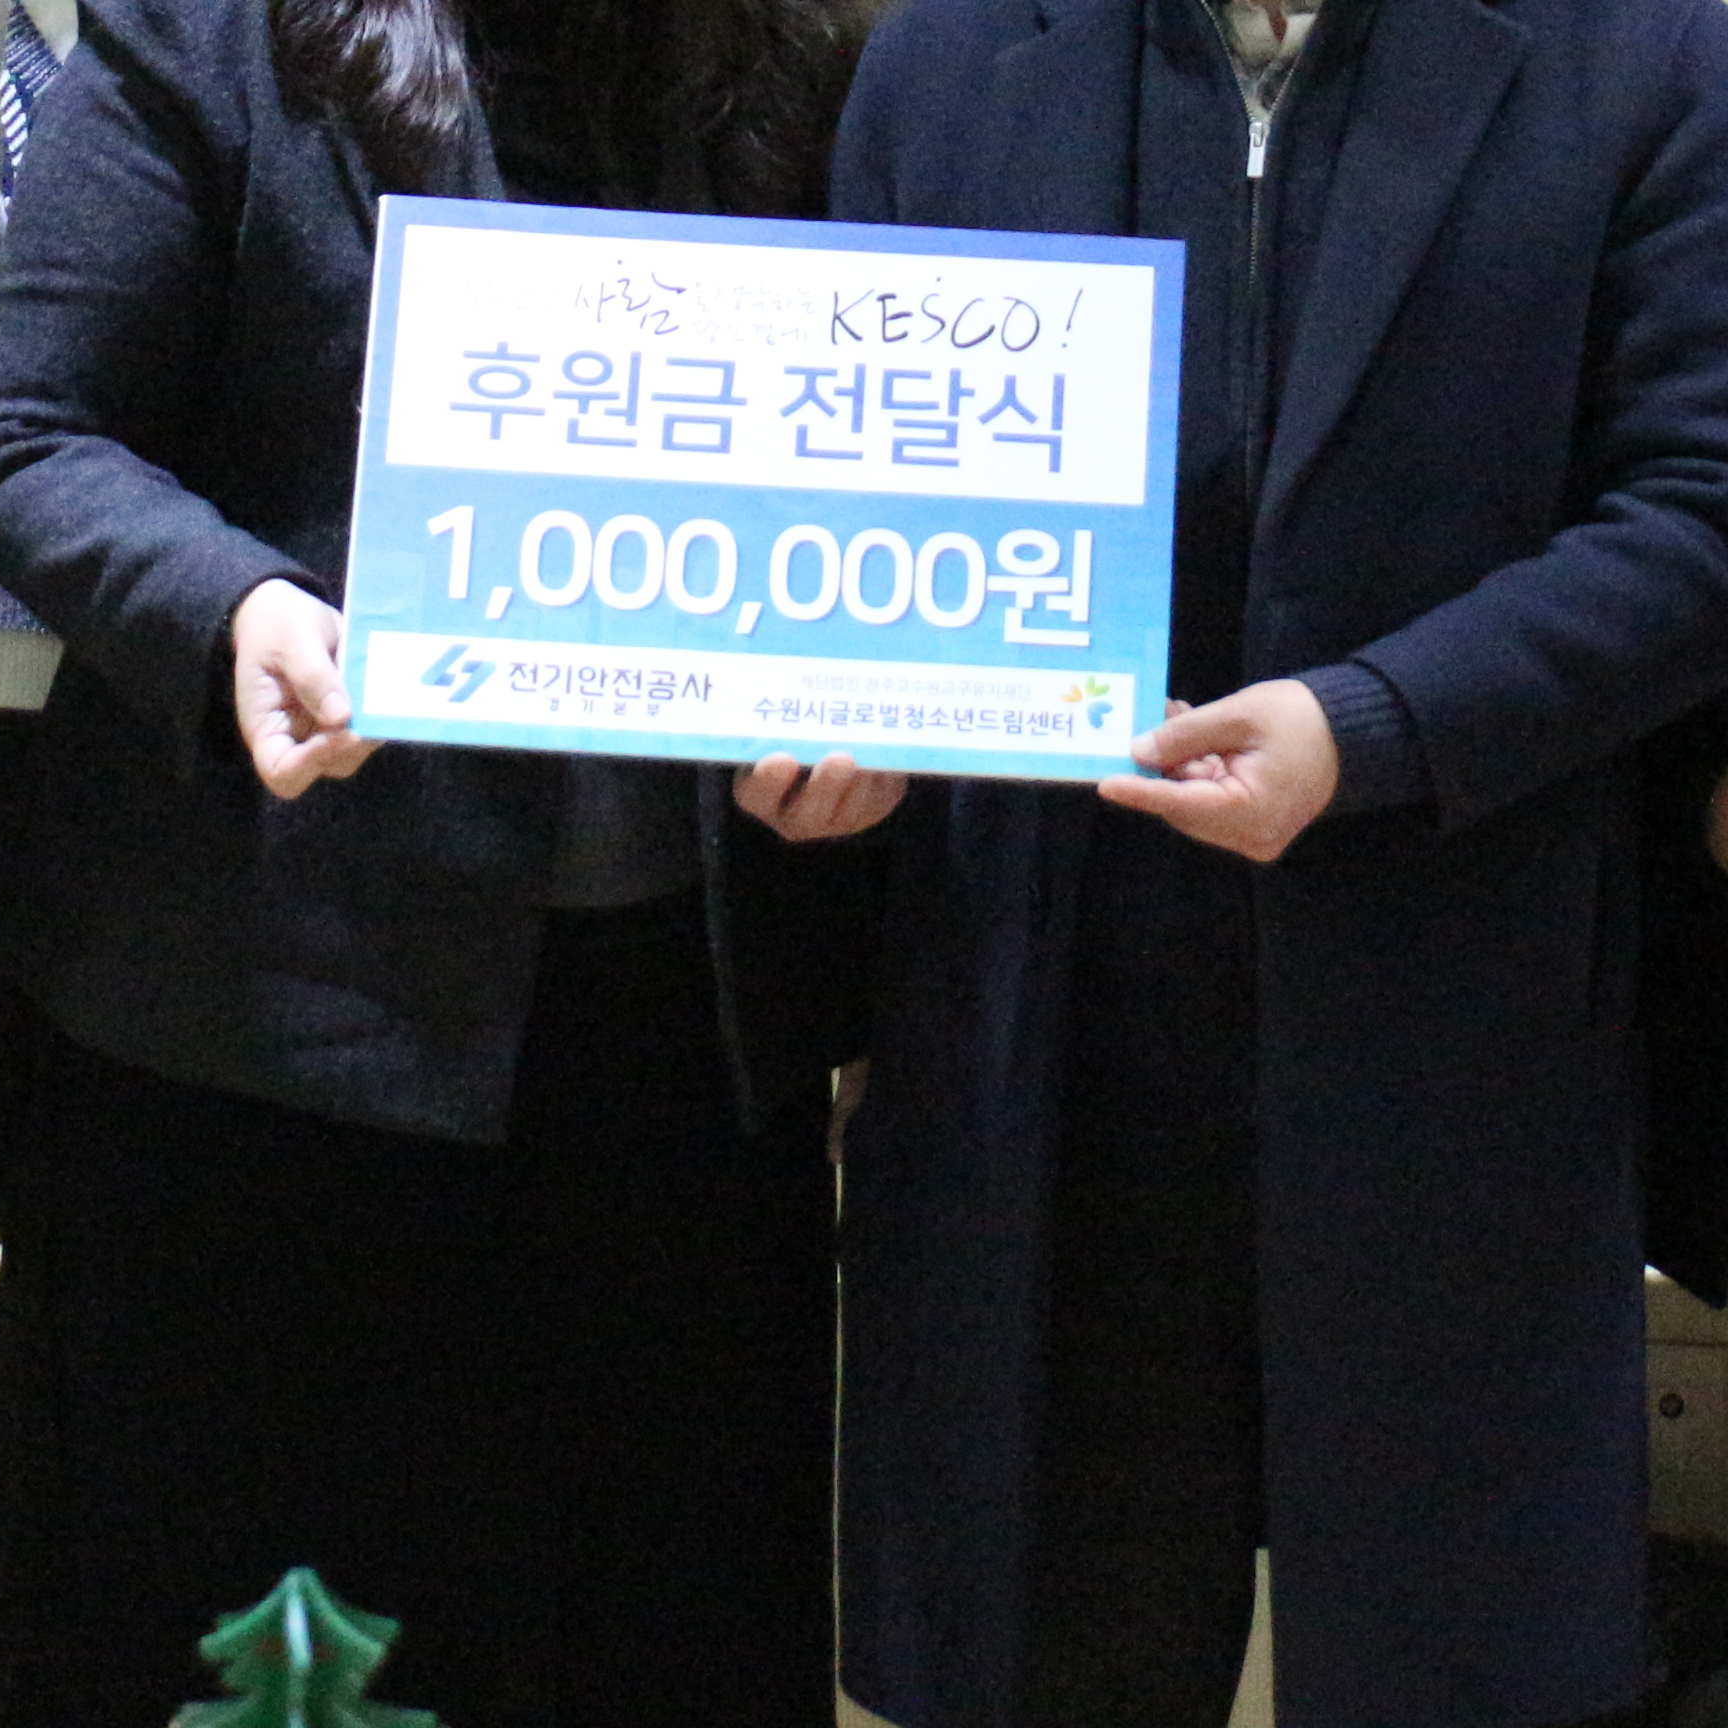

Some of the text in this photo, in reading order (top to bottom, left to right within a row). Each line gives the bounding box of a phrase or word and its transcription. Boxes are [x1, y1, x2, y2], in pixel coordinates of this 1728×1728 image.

[449, 340, 1065, 473] 후원금 전달식
[427, 505, 1094, 647] 1,000,000원
[508, 661, 713, 703] 전기안전공사
[799, 673, 860, 692] 재단법인
[753, 696, 1074, 738] 수원시글로벌청소년드림센터
